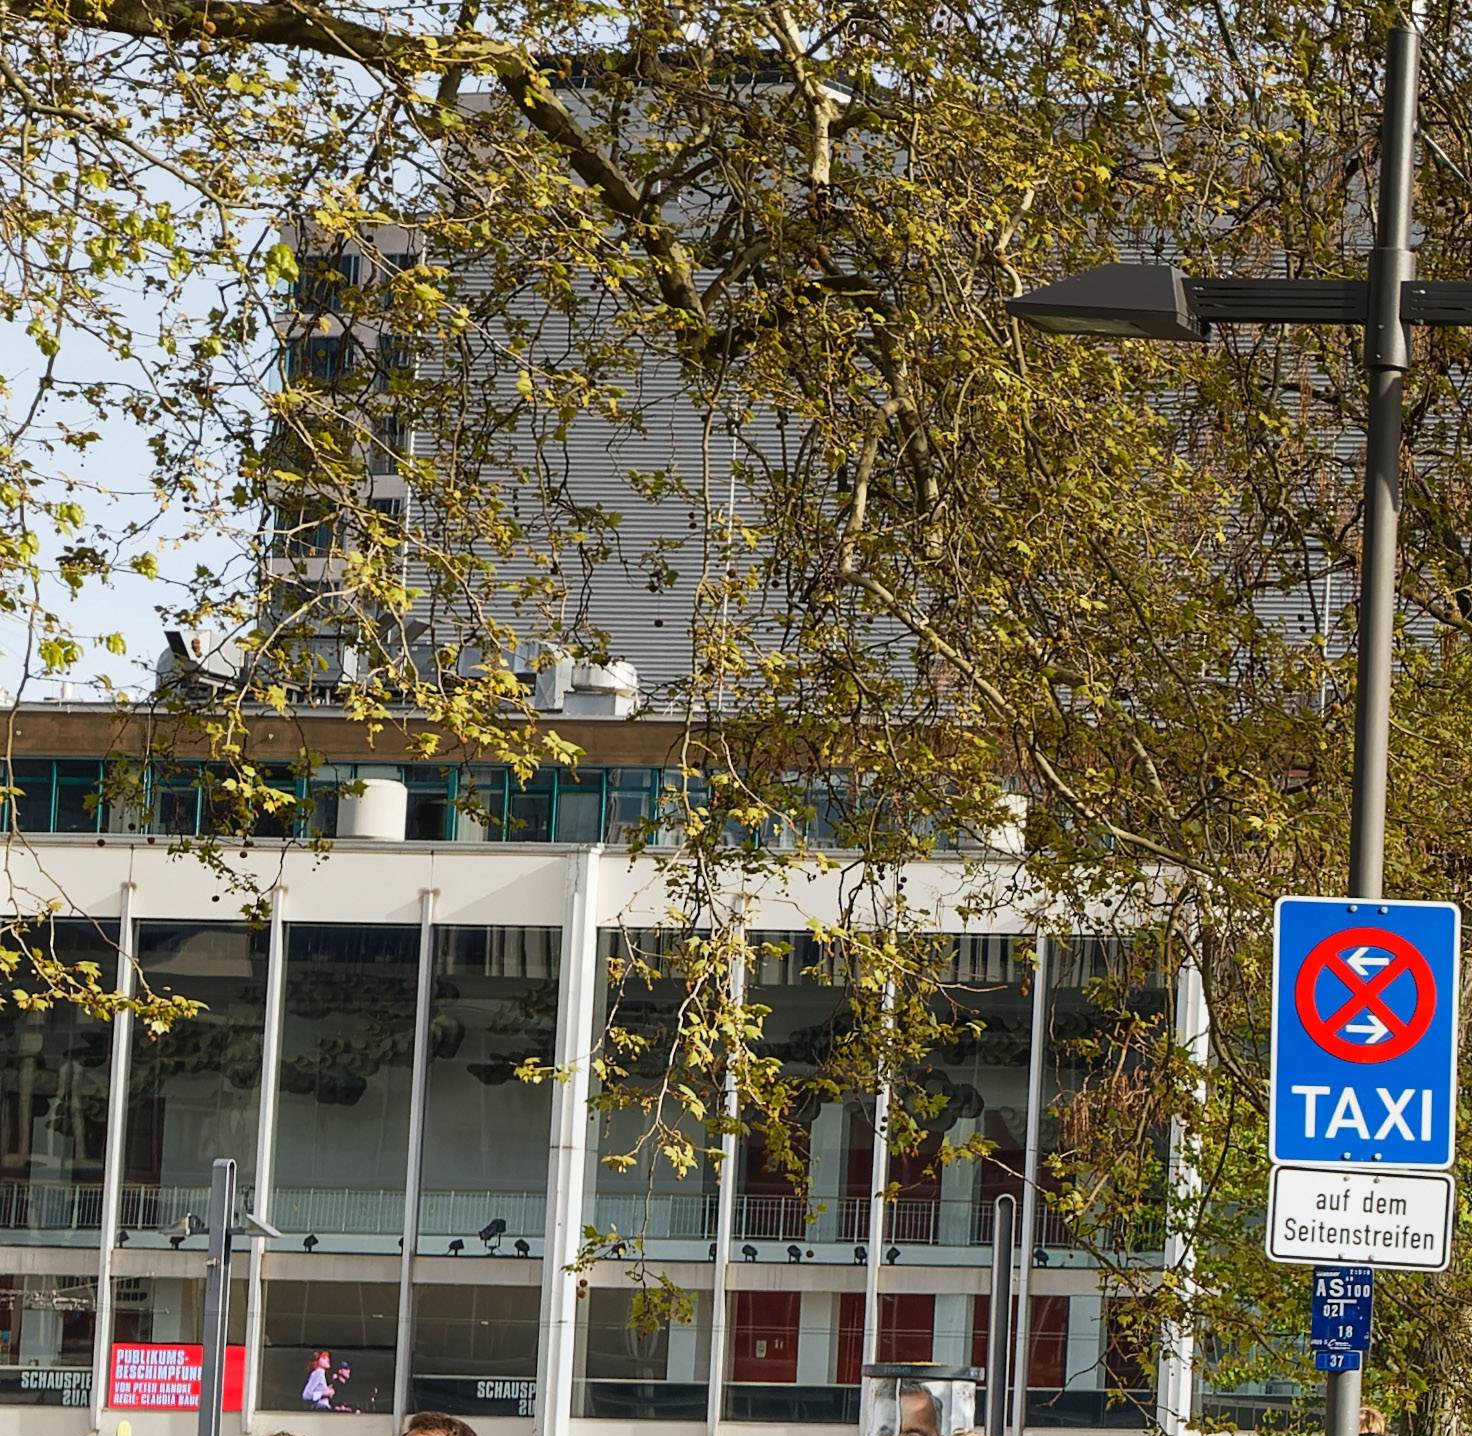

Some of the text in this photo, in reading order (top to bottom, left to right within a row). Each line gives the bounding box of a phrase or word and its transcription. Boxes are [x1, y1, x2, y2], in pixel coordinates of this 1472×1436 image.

[1291, 1085, 1432, 1142] TAXI
[1316, 1189, 1407, 1215] auf dem
[1284, 1218, 1435, 1251] Seitenstreifen
[117, 1349, 189, 1365] PUBLIKUMS-
[1330, 1355, 1344, 1367] 37
